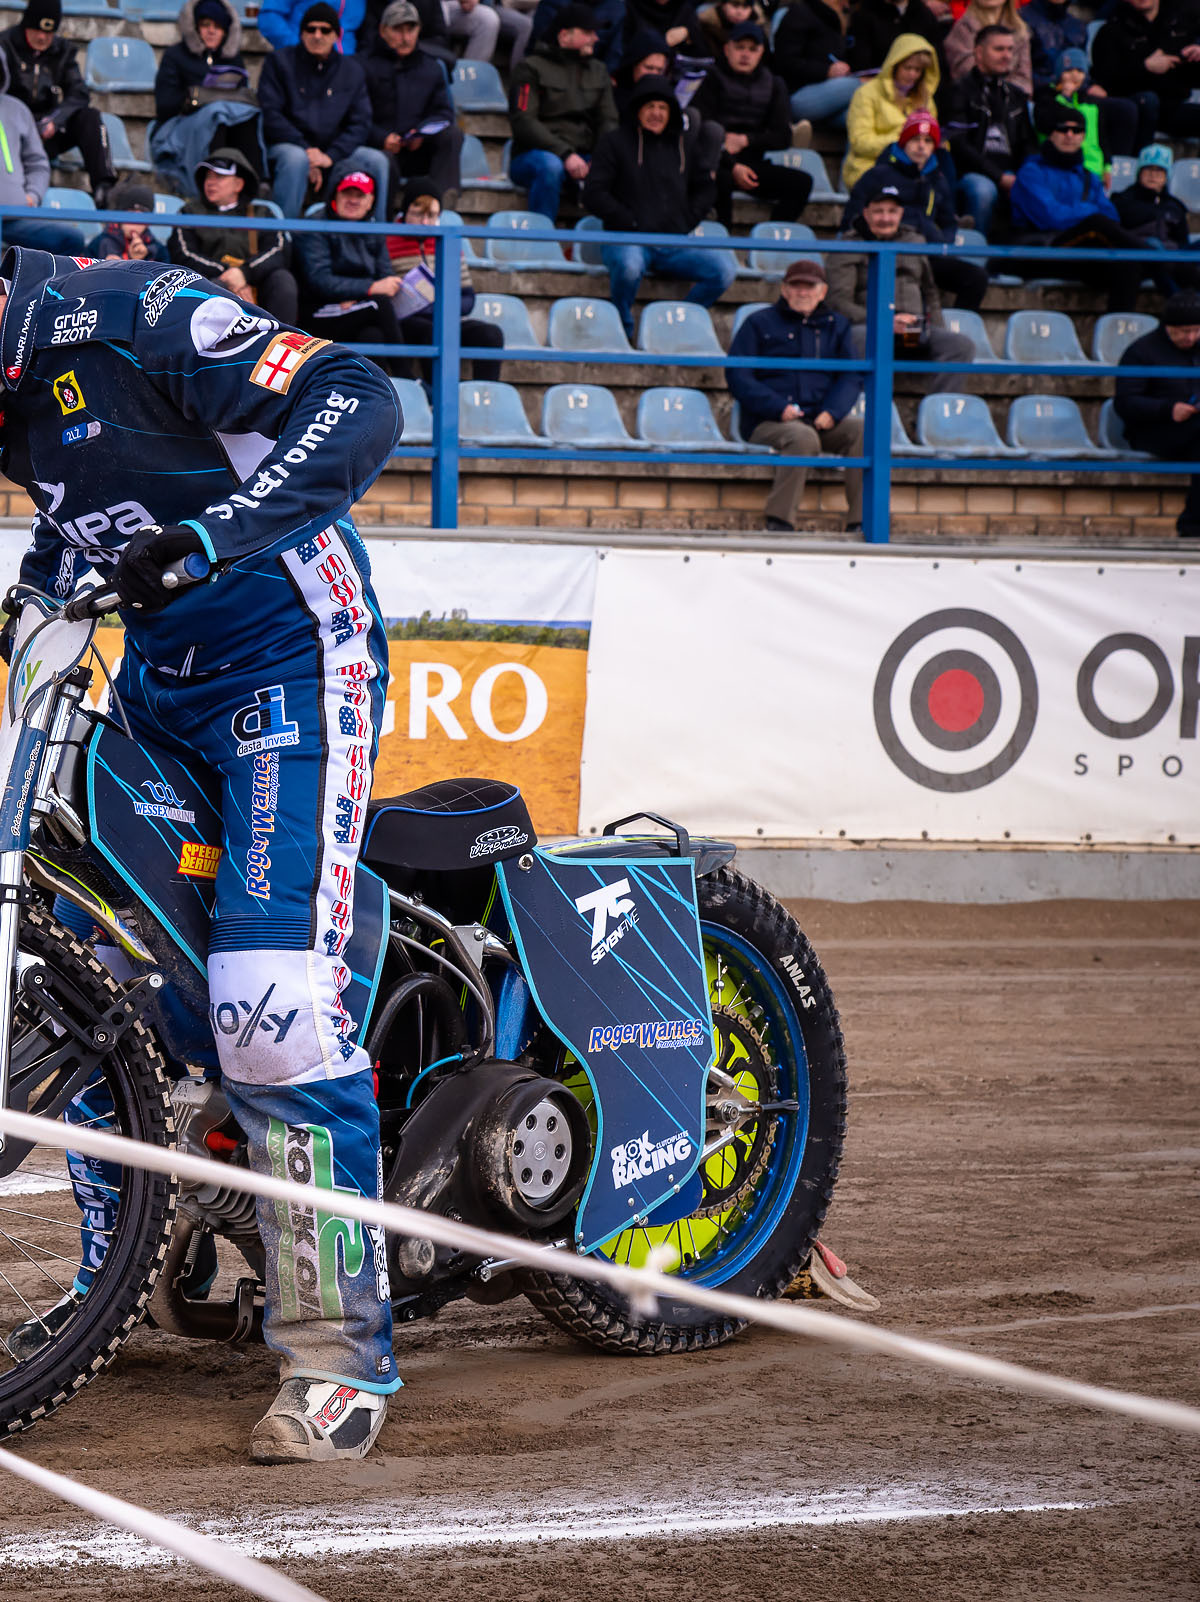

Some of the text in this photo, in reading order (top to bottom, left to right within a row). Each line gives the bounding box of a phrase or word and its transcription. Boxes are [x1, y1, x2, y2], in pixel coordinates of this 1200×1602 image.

[238, 740, 263, 756] dasta
[264, 731, 298, 748] invest
[611, 1138, 692, 1190] RACING
